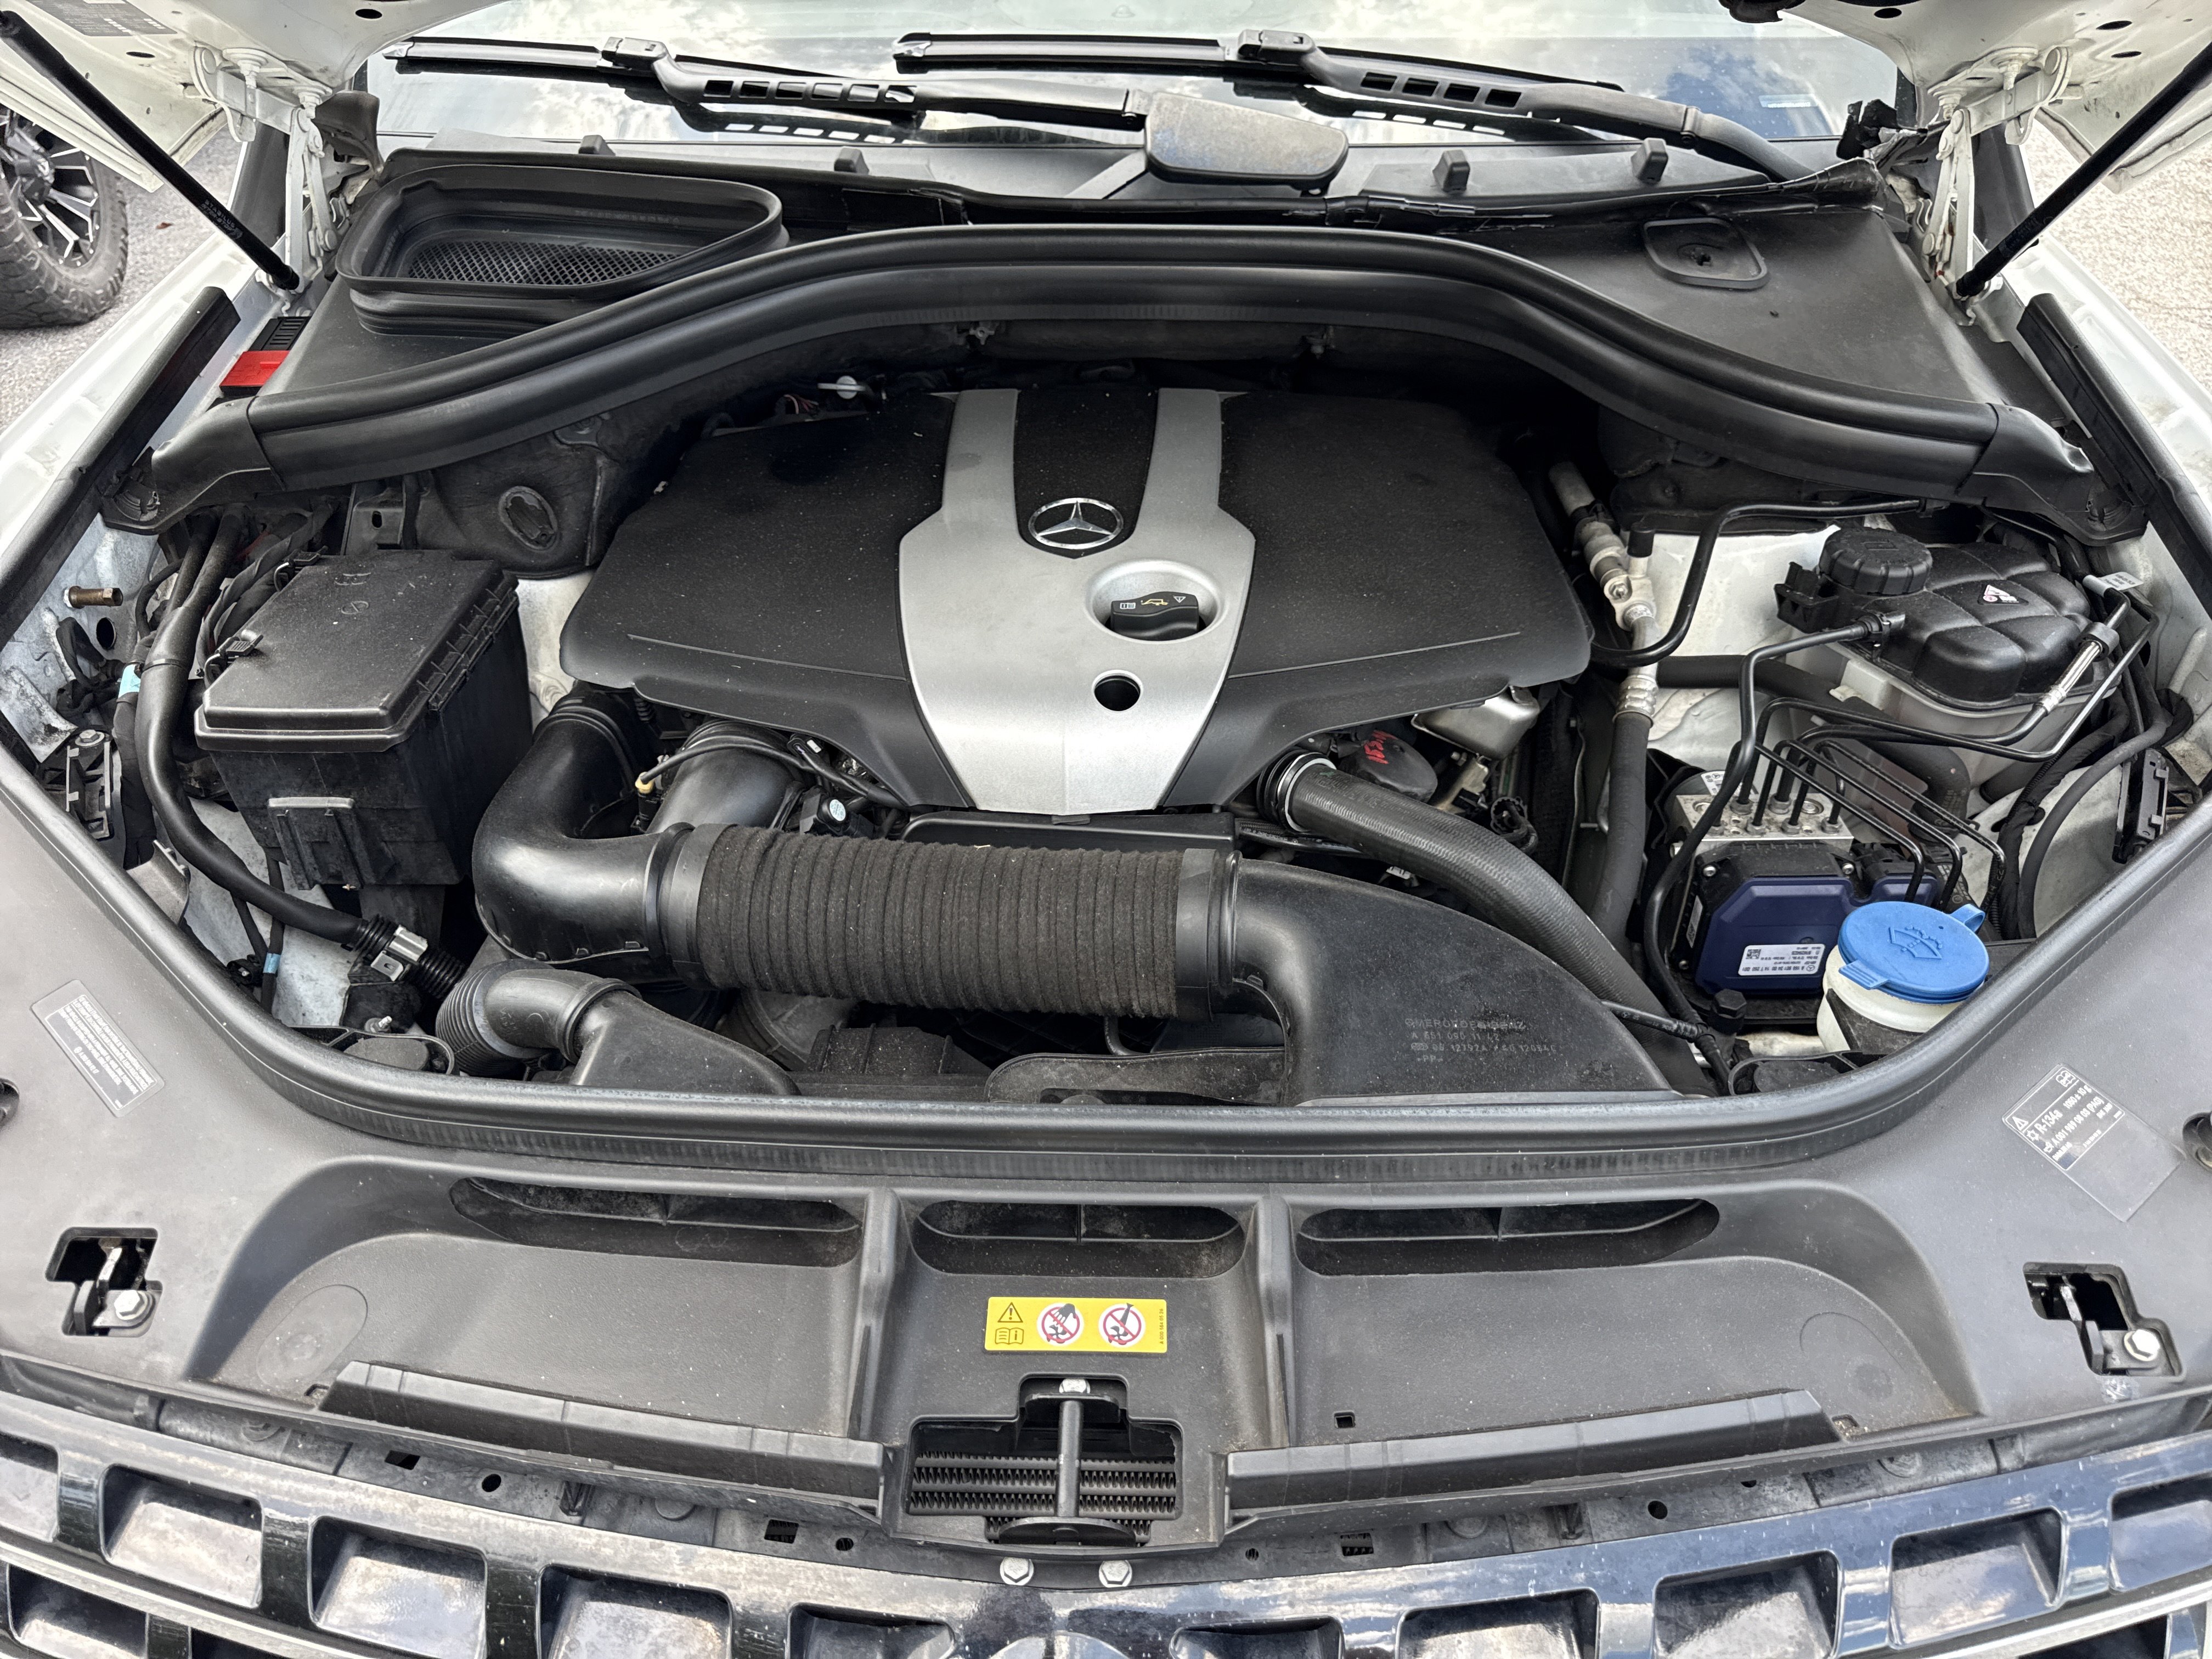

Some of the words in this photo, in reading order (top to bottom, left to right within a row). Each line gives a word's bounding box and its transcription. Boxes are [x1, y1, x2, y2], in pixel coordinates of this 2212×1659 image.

[2034, 1109, 2063, 1133] R-134a
[2077, 1087, 2086, 1096] 10
[2051, 1137, 2059, 1146] A
[2055, 1128, 2068, 1141] 001
[2086, 1096, 2104, 1112] (PAG)
